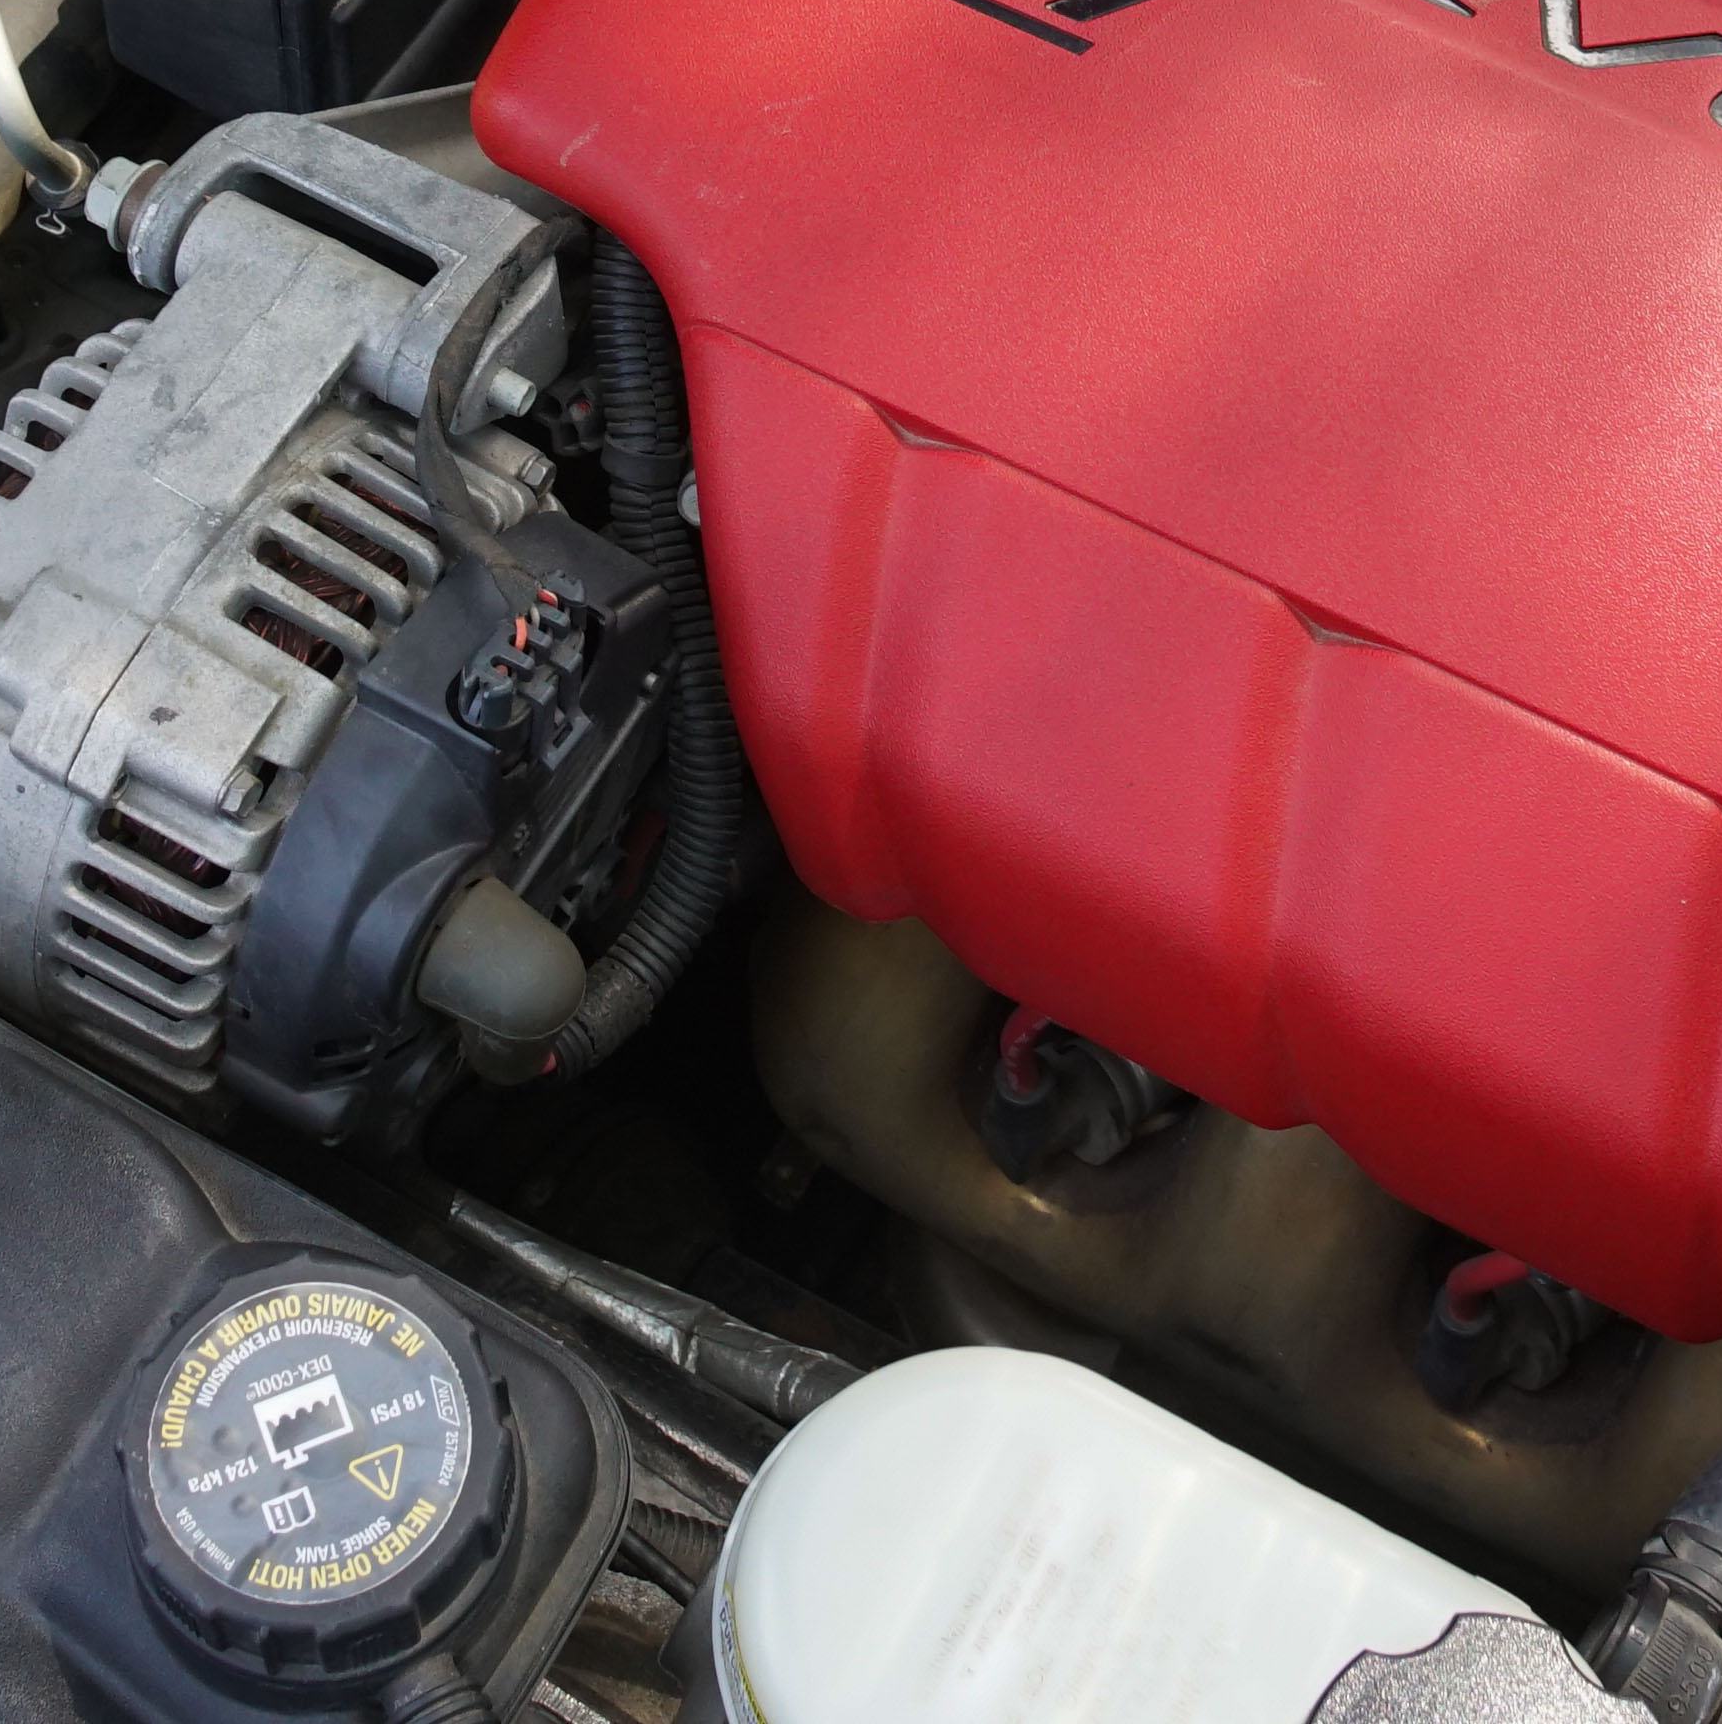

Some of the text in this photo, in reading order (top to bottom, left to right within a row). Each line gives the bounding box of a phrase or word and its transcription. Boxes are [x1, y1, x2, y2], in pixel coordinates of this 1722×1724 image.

[216, 1295, 301, 1347] OUVRIR
[308, 1293, 397, 1332] JAMAIS
[391, 1322, 426, 1359] NE
[196, 1318, 374, 1408] RÉSERVOIR D'EXPANSION
[160, 1359, 207, 1449] CHAUD!
[371, 1389, 426, 1425] 18 PSI
[187, 1455, 259, 1494] 124 kPa
[176, 1506, 196, 1532] USA
[198, 1535, 236, 1571] Printed
[247, 1498, 437, 1591] NEVER OPEN HOT!
[295, 1515, 392, 1564] SURGE TANK
